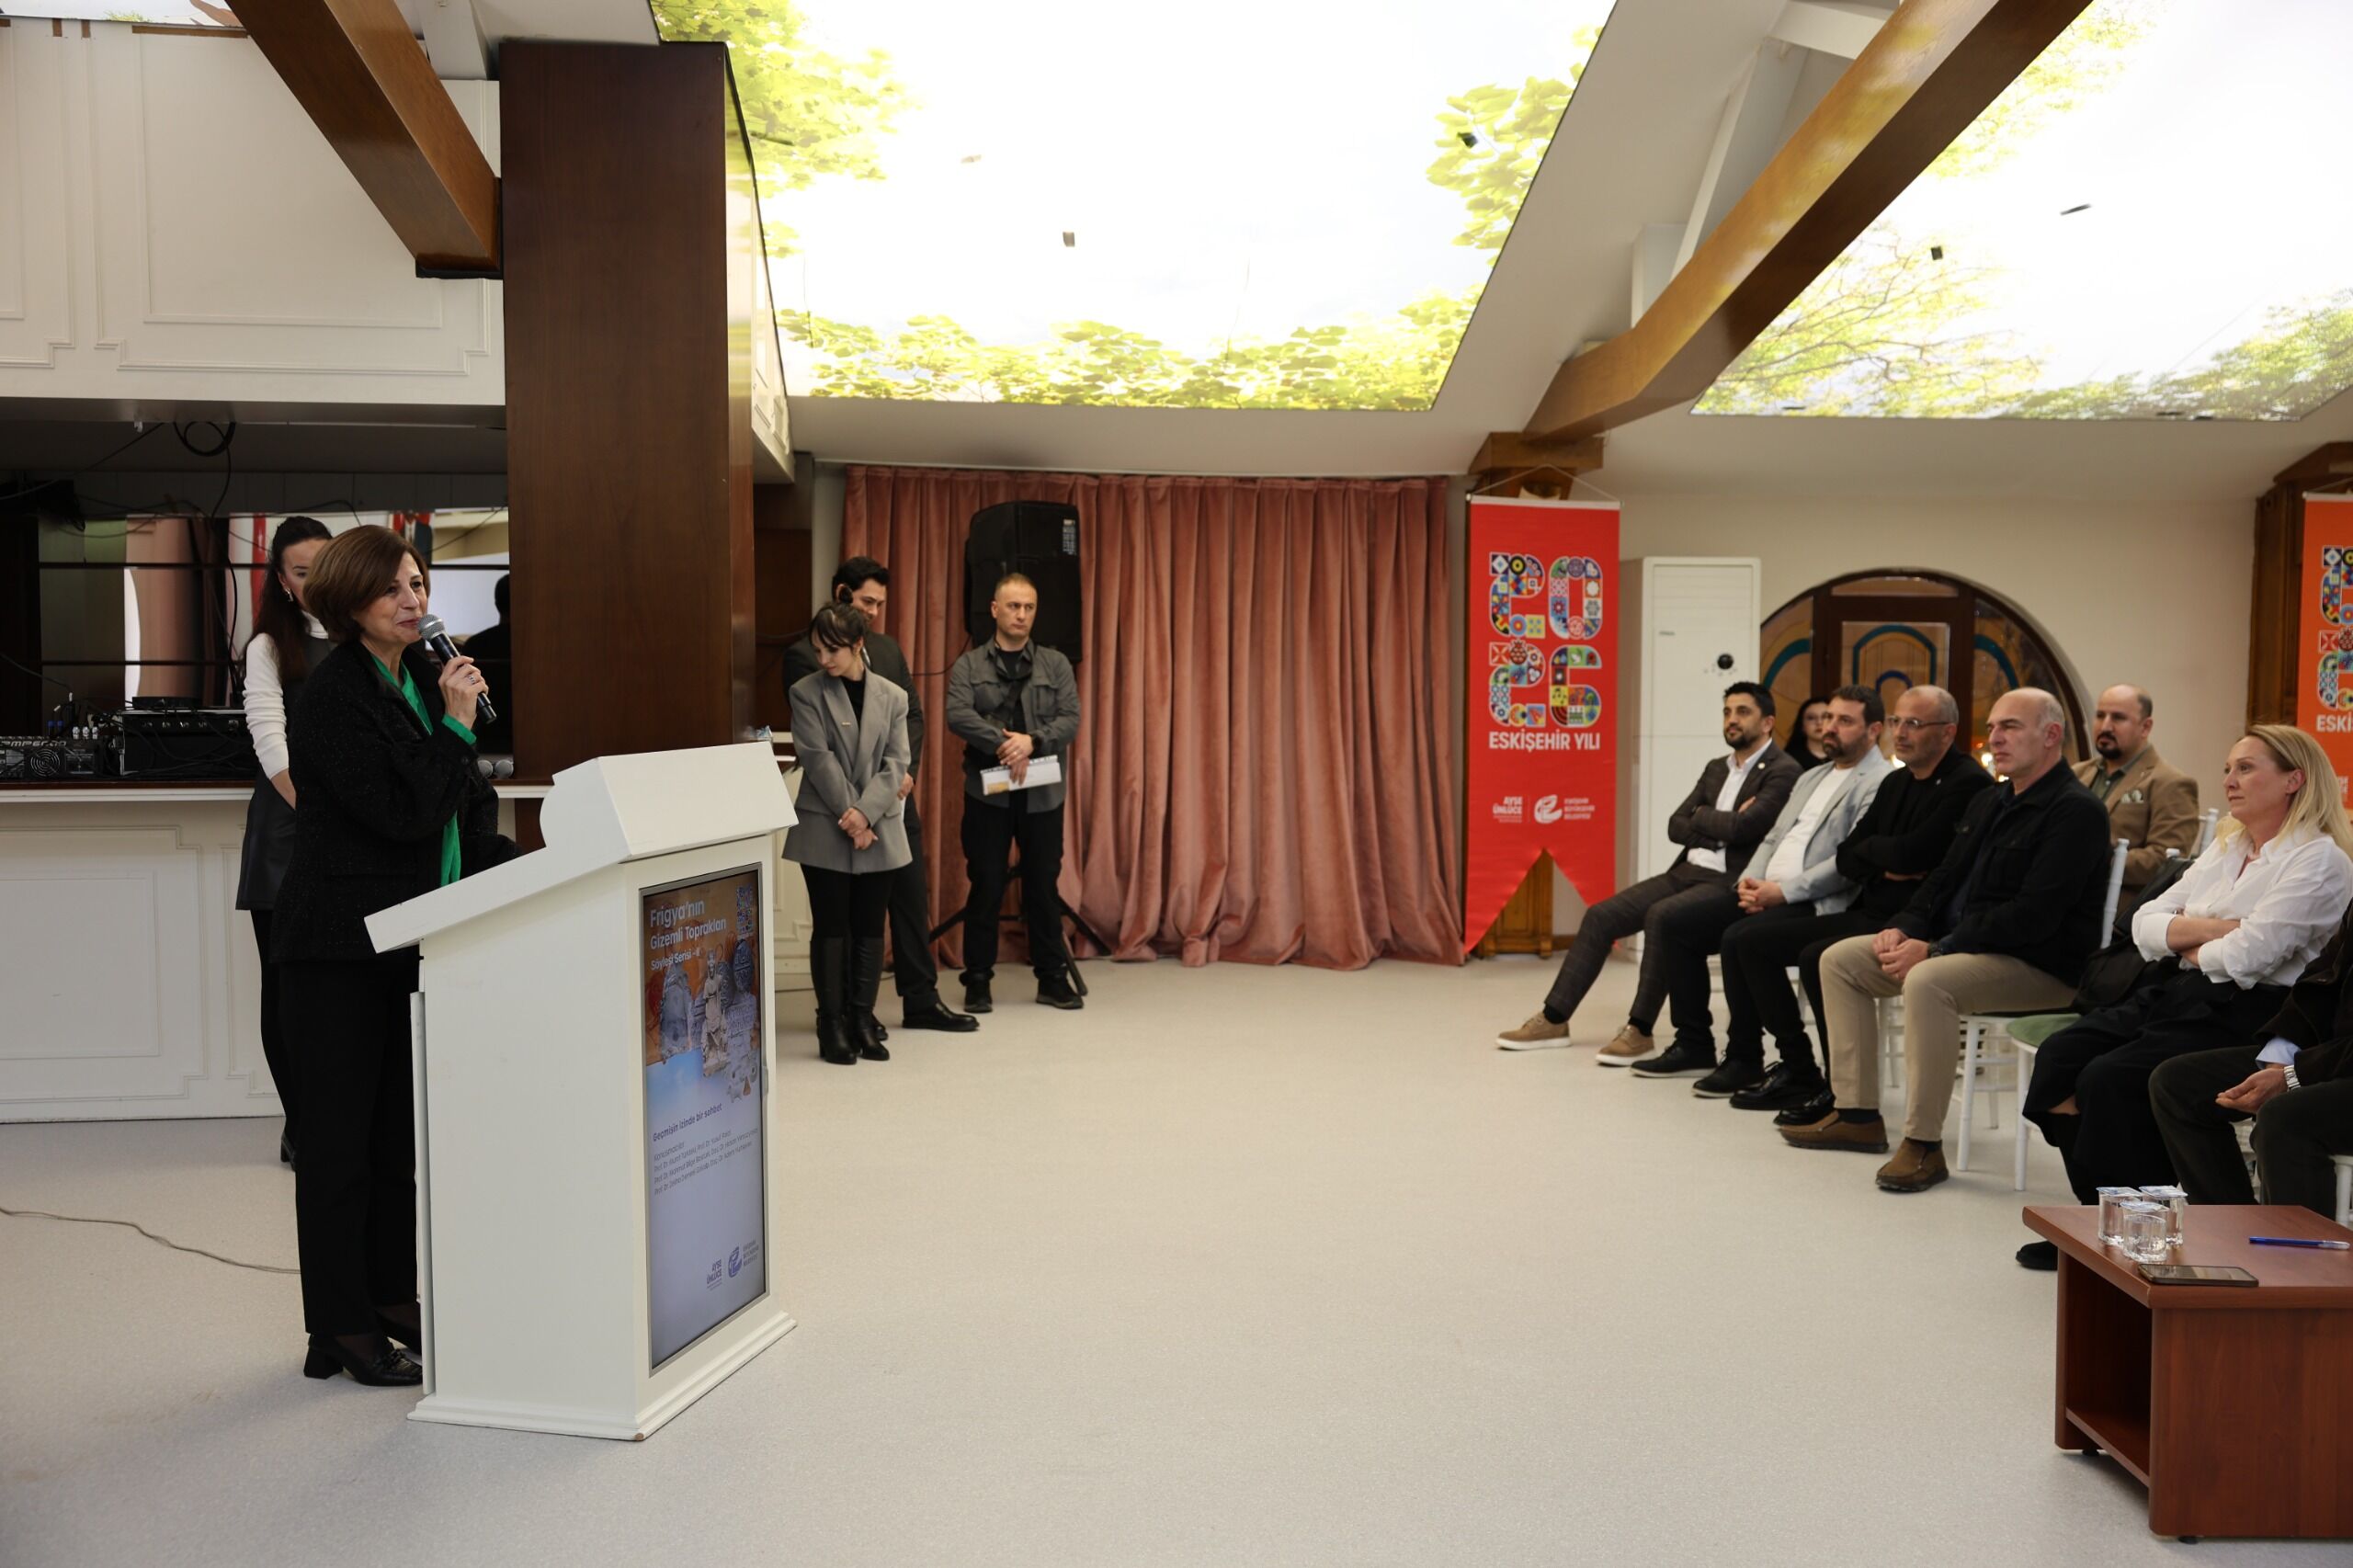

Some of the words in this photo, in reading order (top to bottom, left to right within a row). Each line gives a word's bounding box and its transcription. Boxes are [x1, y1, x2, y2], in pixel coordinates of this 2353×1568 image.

[1489, 730, 1571, 752] ESKİŞEHİR
[1574, 733, 1600, 751] YILI
[650, 927, 683, 949] Gizemli
[675, 949, 692, 963] Serisi
